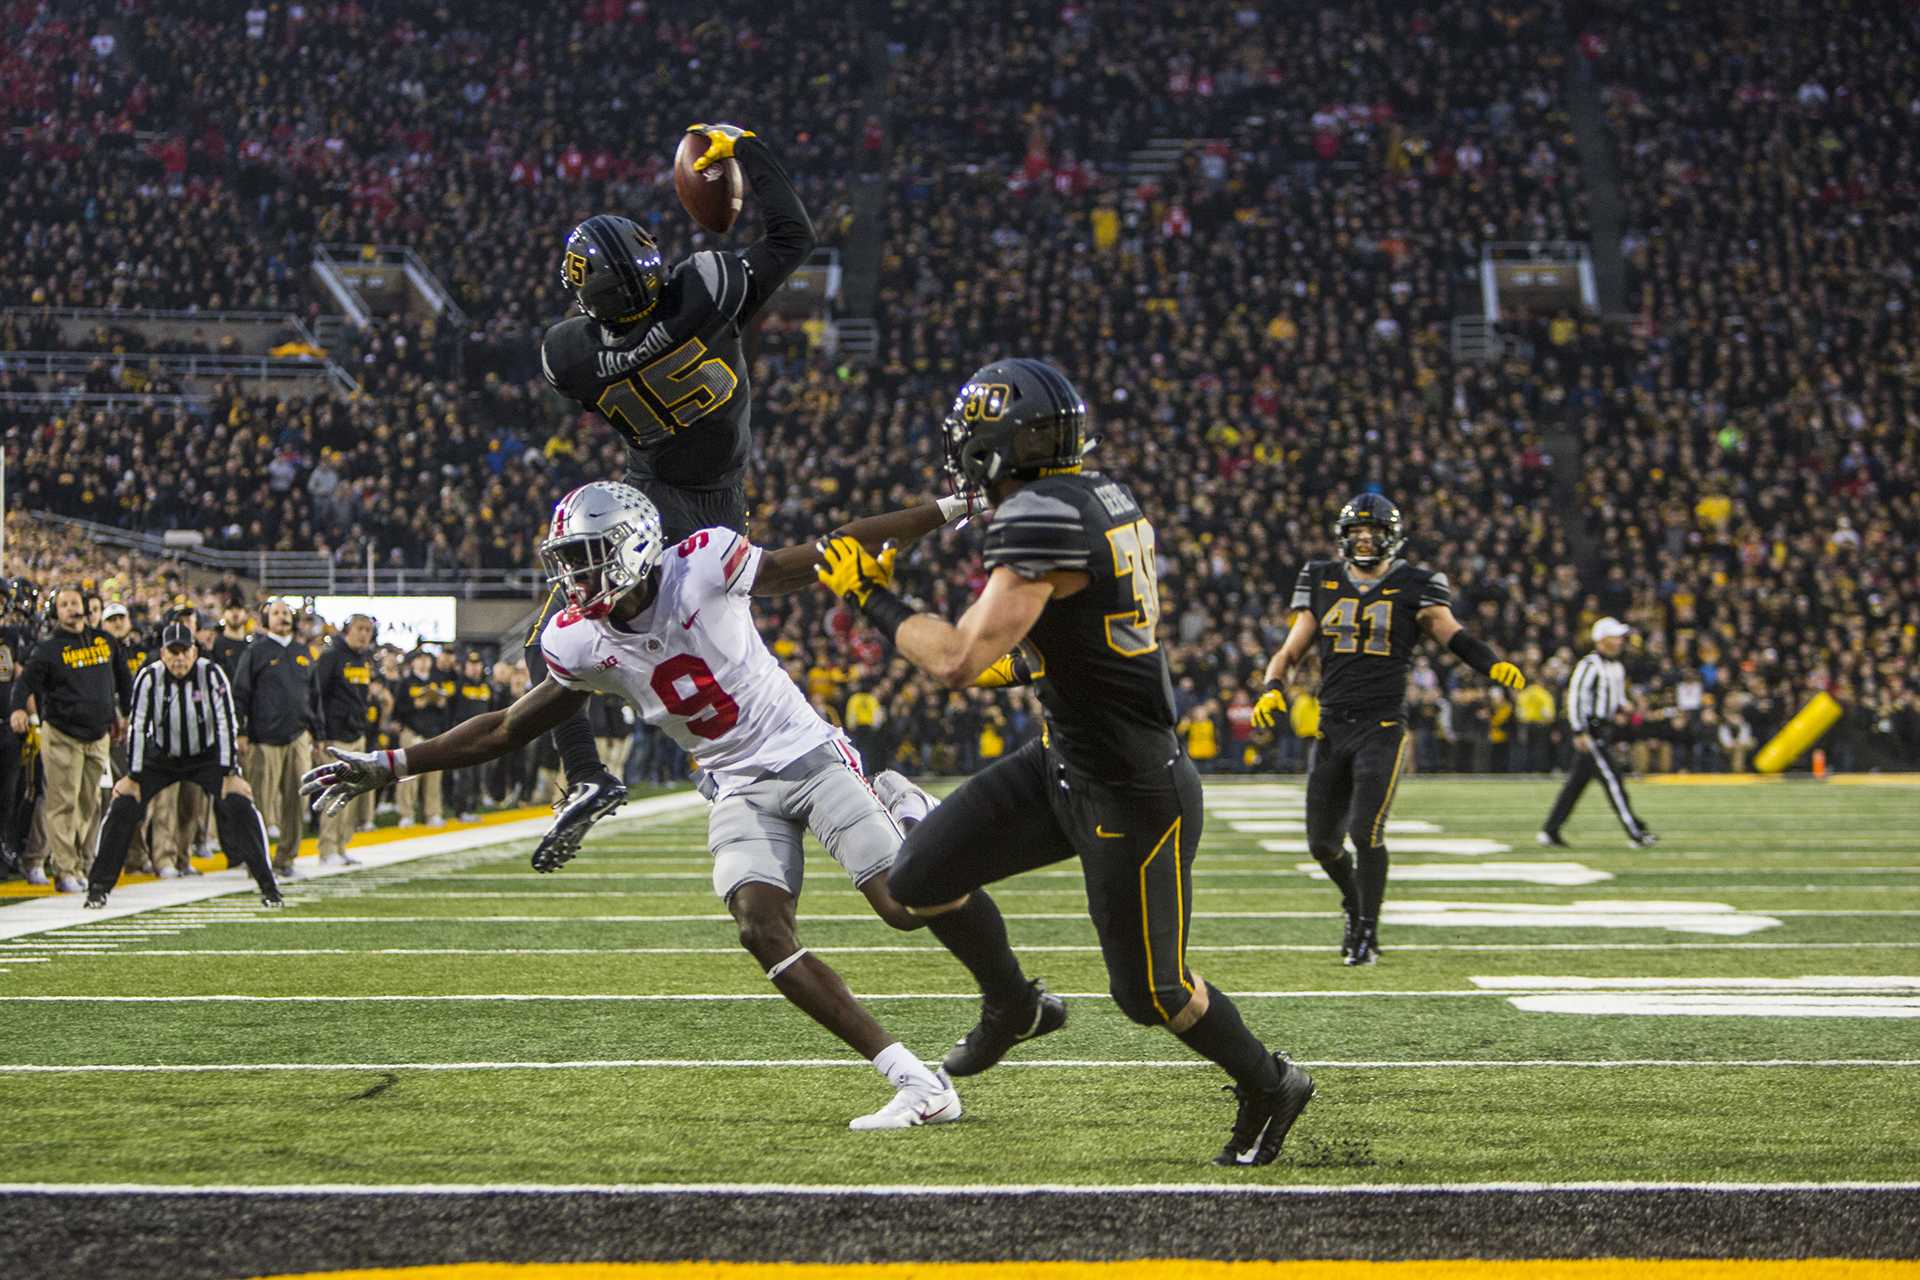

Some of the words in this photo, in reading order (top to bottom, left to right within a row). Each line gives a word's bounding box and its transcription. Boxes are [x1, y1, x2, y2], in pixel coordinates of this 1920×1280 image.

[596, 321, 674, 378] JACKSON
[597, 336, 738, 446] 15
[965, 383, 1010, 421] 30
[1320, 598, 1393, 656] 41
[651, 653, 739, 740] 9
